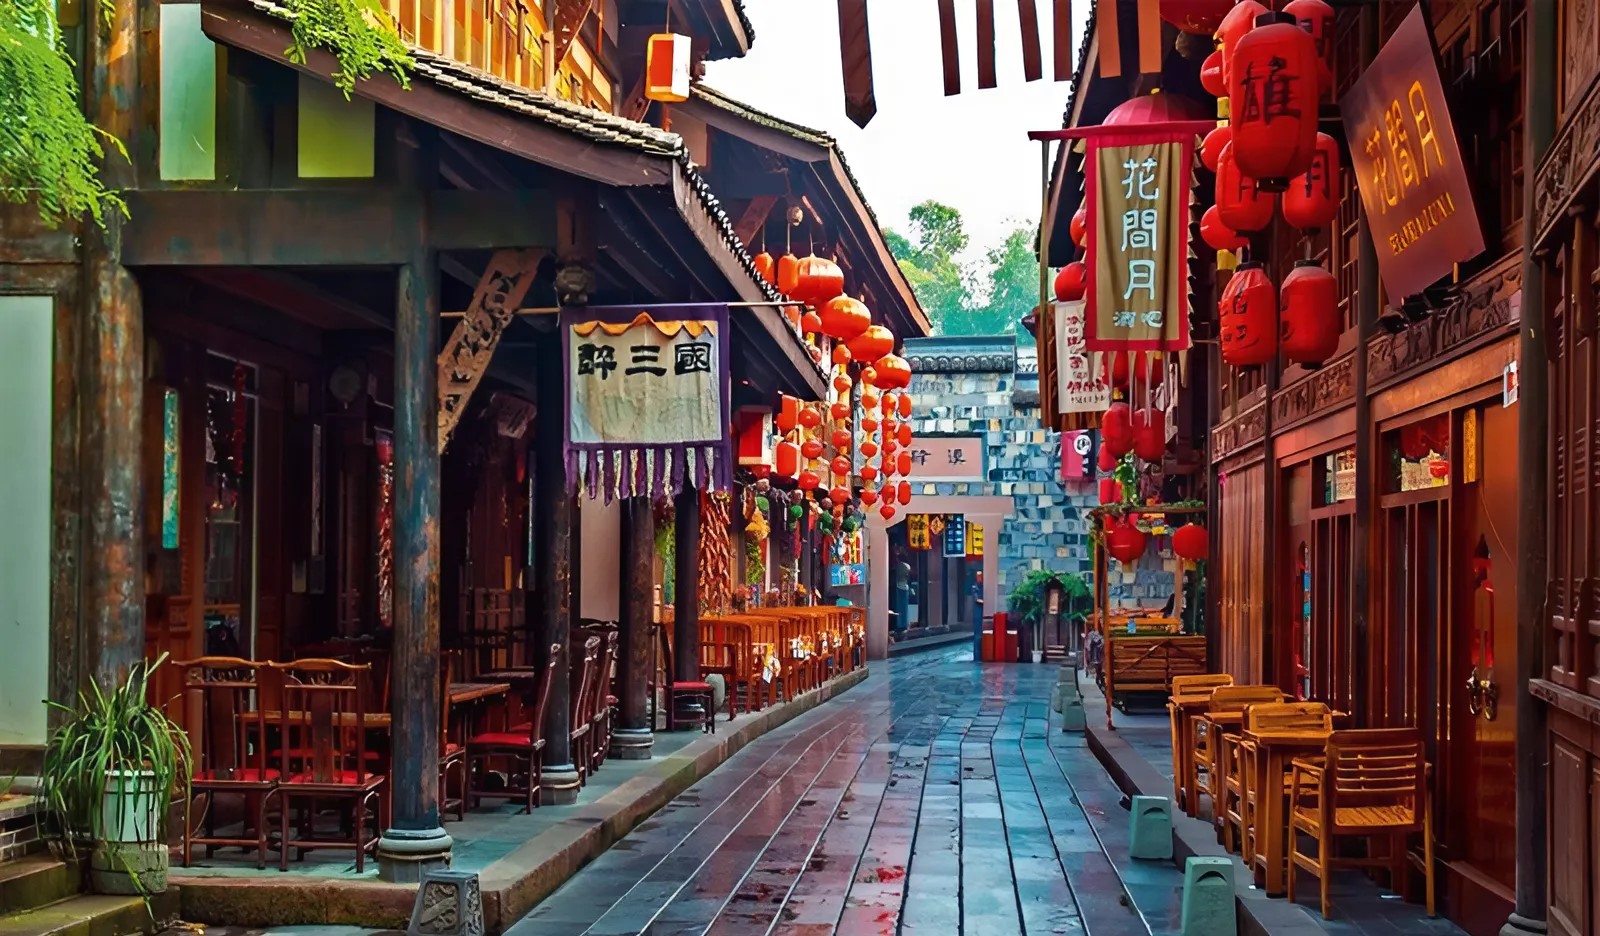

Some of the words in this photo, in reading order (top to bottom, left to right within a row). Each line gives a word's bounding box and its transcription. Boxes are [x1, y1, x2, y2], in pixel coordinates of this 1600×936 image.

[1366, 80, 1443, 215] 花間月
[1121, 158, 1159, 300] 花間月
[577, 342, 711, 380] 醉三國
